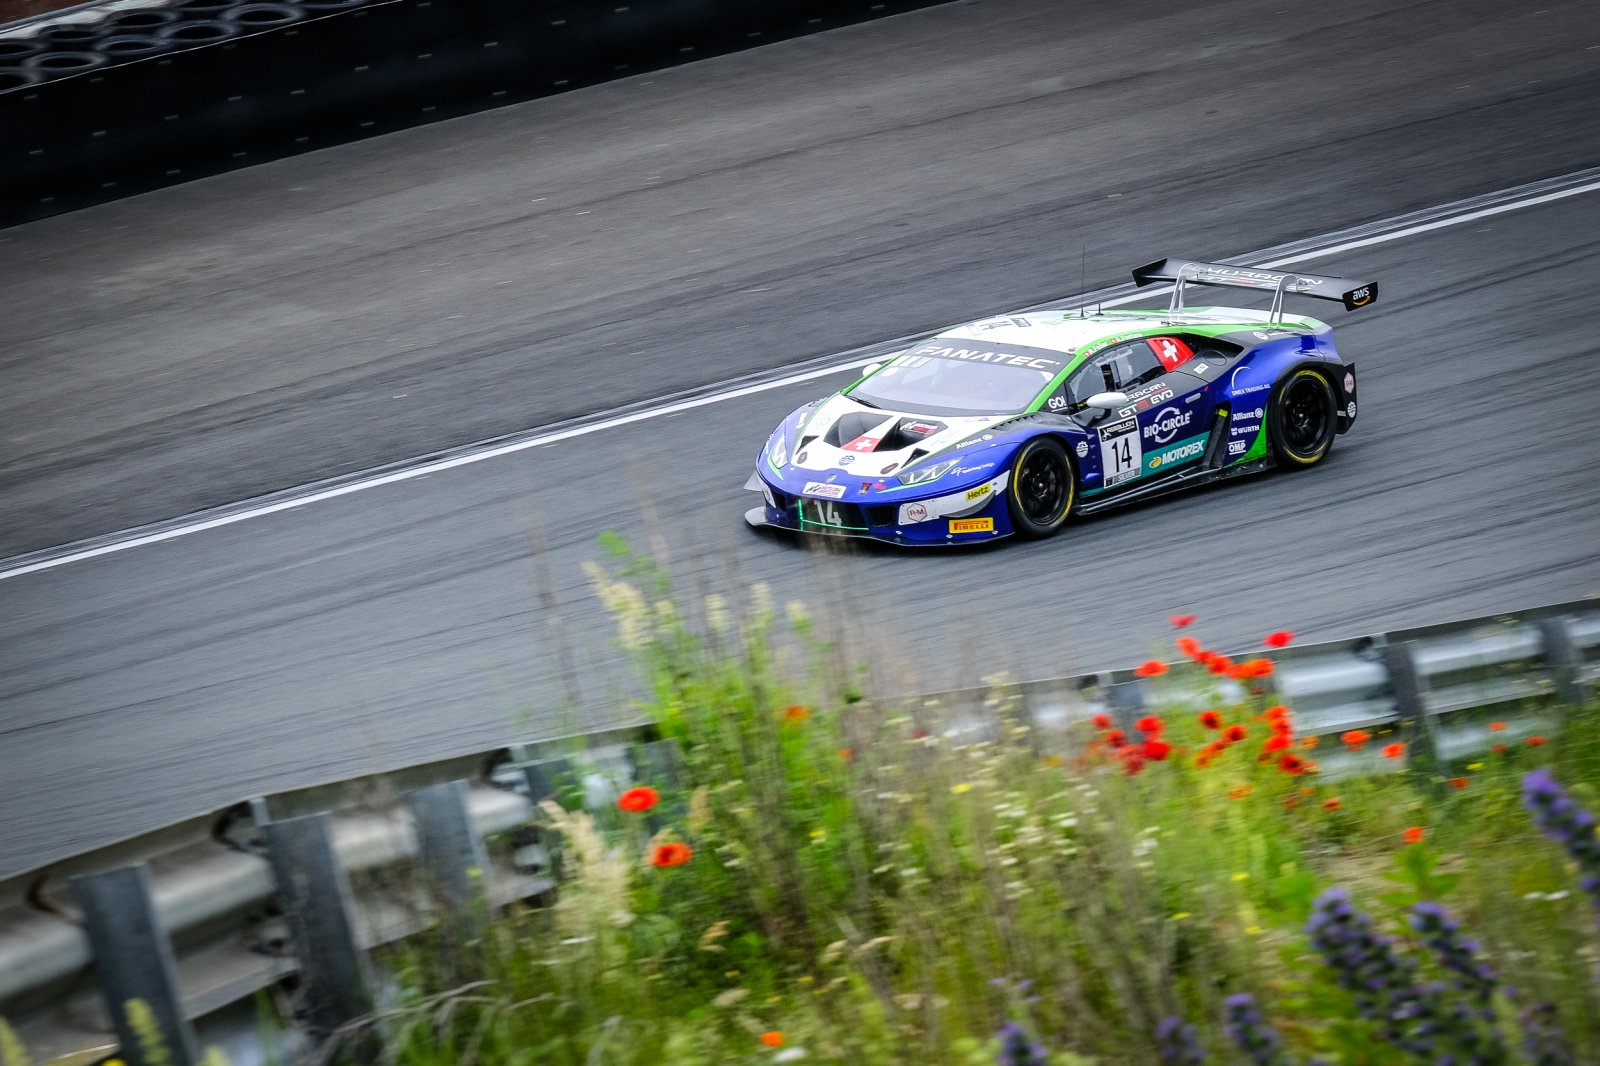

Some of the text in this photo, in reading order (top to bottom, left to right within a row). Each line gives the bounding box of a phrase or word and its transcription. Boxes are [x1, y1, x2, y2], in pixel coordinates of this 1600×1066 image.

[1353, 287, 1370, 300] aws
[915, 346, 1058, 369] FANATEC
[1126, 381, 1167, 402] RACAN
[1048, 396, 1067, 409] GO!
[1118, 389, 1174, 418] GT3 EVO
[1232, 411, 1255, 421] Allianz
[1143, 412, 1191, 438] BIO-CIRCLE
[956, 438, 983, 450] Allianz
[1161, 439, 1205, 465] MOTOREX
[1228, 442, 1246, 453] OMP
[1111, 437, 1133, 473] 14
[967, 486, 989, 500] Hertz
[814, 500, 842, 527] 14
[953, 520, 989, 531] PIRELLI
